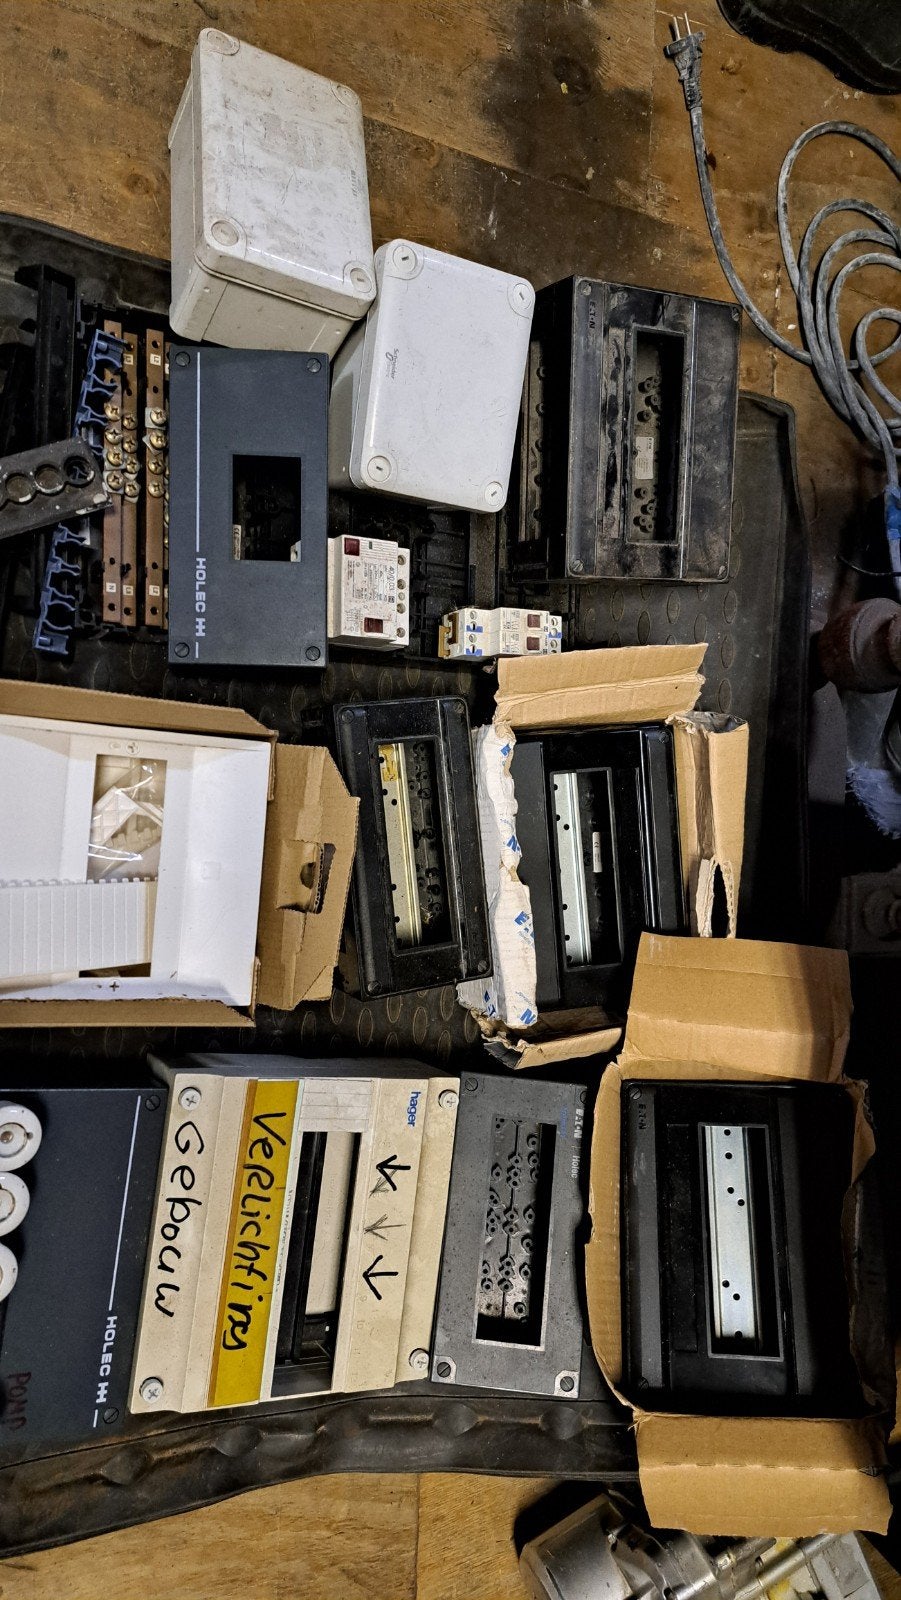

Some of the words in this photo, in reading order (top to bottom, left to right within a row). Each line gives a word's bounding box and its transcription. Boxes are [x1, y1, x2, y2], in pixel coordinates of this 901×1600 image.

[195, 557, 207, 613] HOLEC
[407, 1091, 421, 1128] hager
[154, 1121, 205, 1318] Gebouw
[99, 1315, 118, 1377] HOLEC
